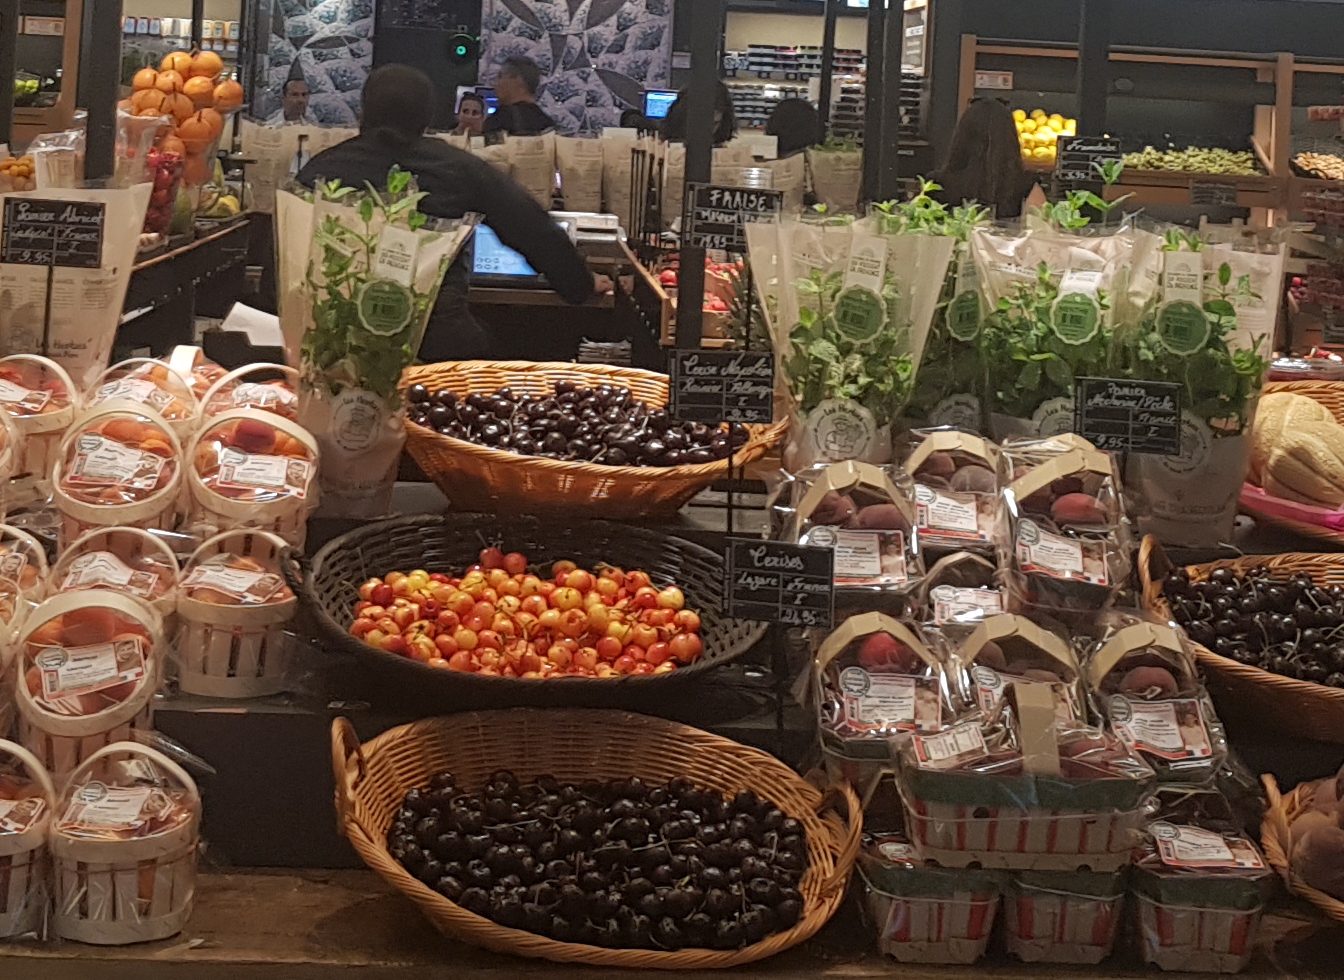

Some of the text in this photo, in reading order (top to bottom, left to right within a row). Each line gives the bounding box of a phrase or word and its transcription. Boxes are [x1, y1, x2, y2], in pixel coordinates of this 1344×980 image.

[709, 189, 767, 212] FRAISE
[59, 204, 105, 225] Abricot
[823, 407, 837, 416] Les
[748, 545, 805, 571] Cerises
